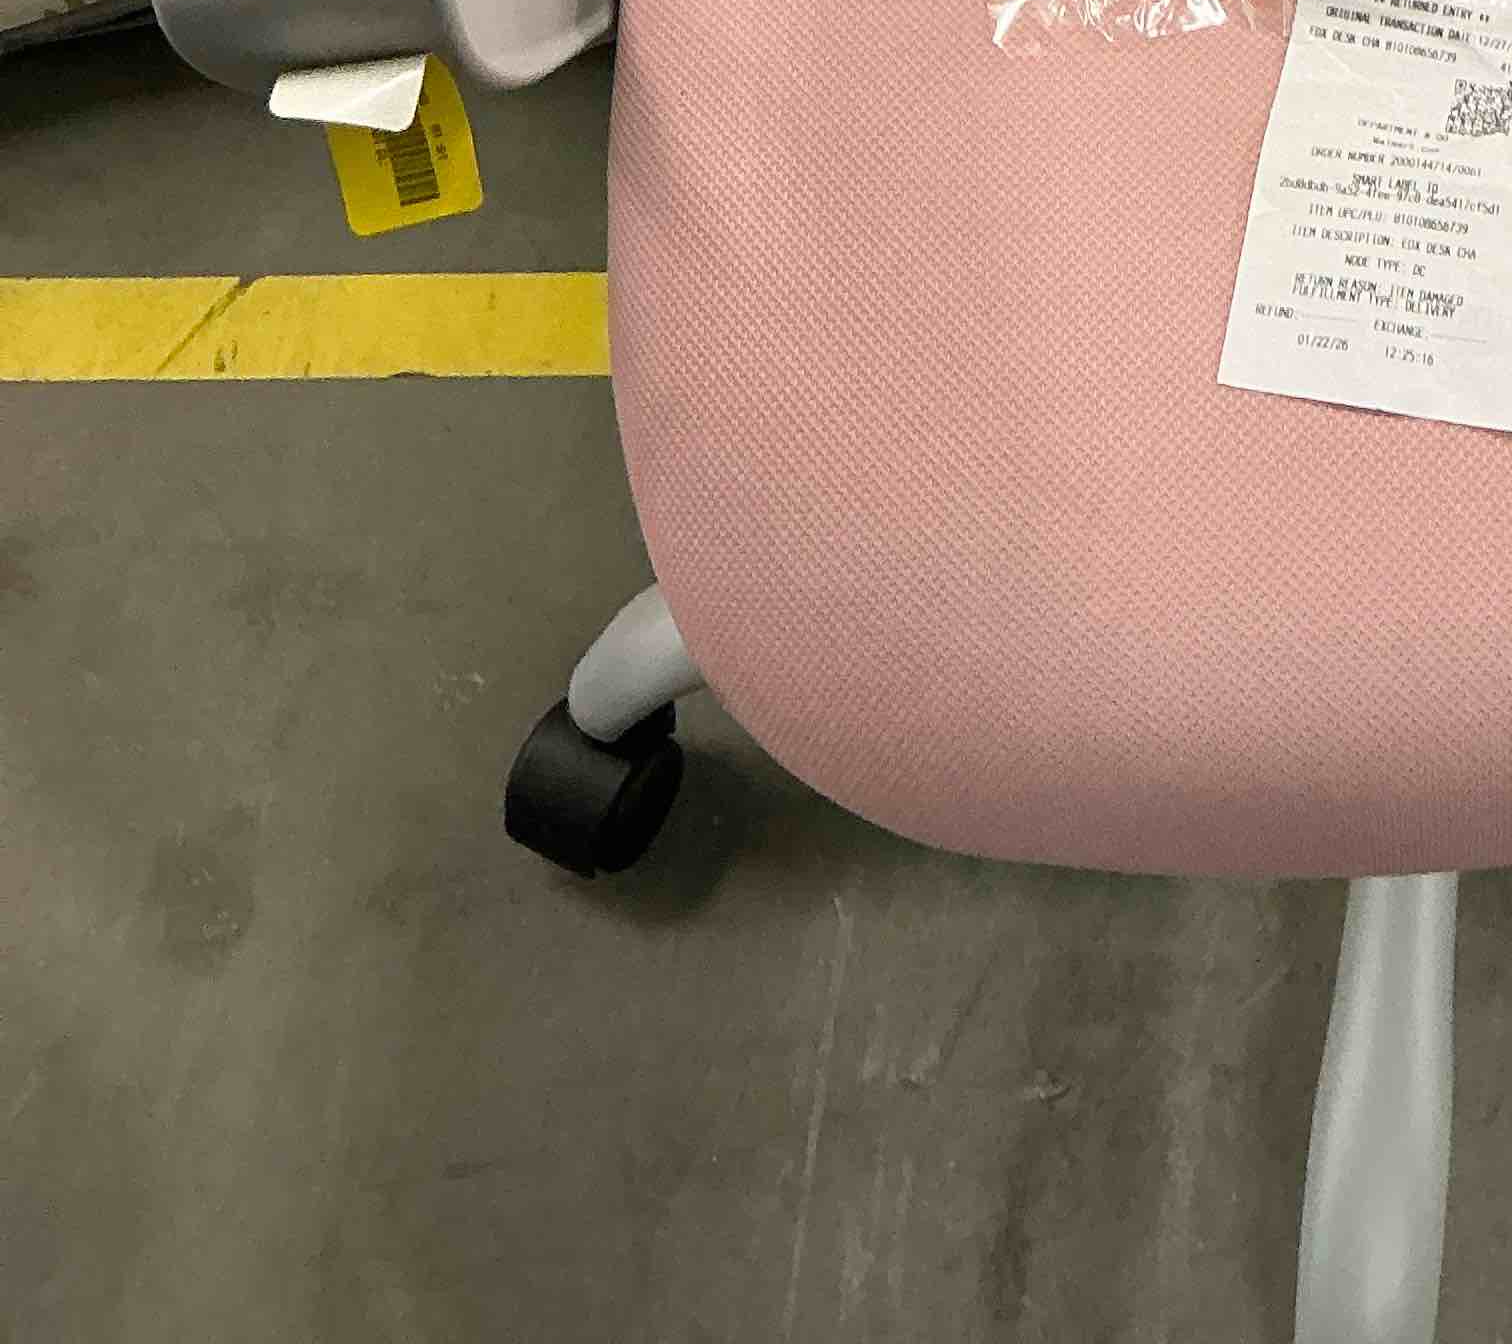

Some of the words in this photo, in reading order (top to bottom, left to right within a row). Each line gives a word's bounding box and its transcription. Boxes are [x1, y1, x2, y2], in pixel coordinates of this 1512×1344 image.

[1326, 6, 1371, 24] ORIGINAL
[1379, 12, 1444, 38] TRANSACTION
[1442, 3, 1473, 20] ENTRY
[1347, 151, 1385, 165] NUMBER
[1292, 224, 1317, 239] ITEM
[1425, 243, 1451, 257] DESK
[1344, 254, 1369, 269] NODE
[1412, 264, 1427, 277] DC
[1295, 272, 1334, 288] RETURN
[1419, 288, 1464, 307] DAMAGED
[1405, 299, 1457, 319] DELIVERY
[1297, 334, 1350, 352] 01/22/26
[1384, 345, 1435, 367] 12:25:16
